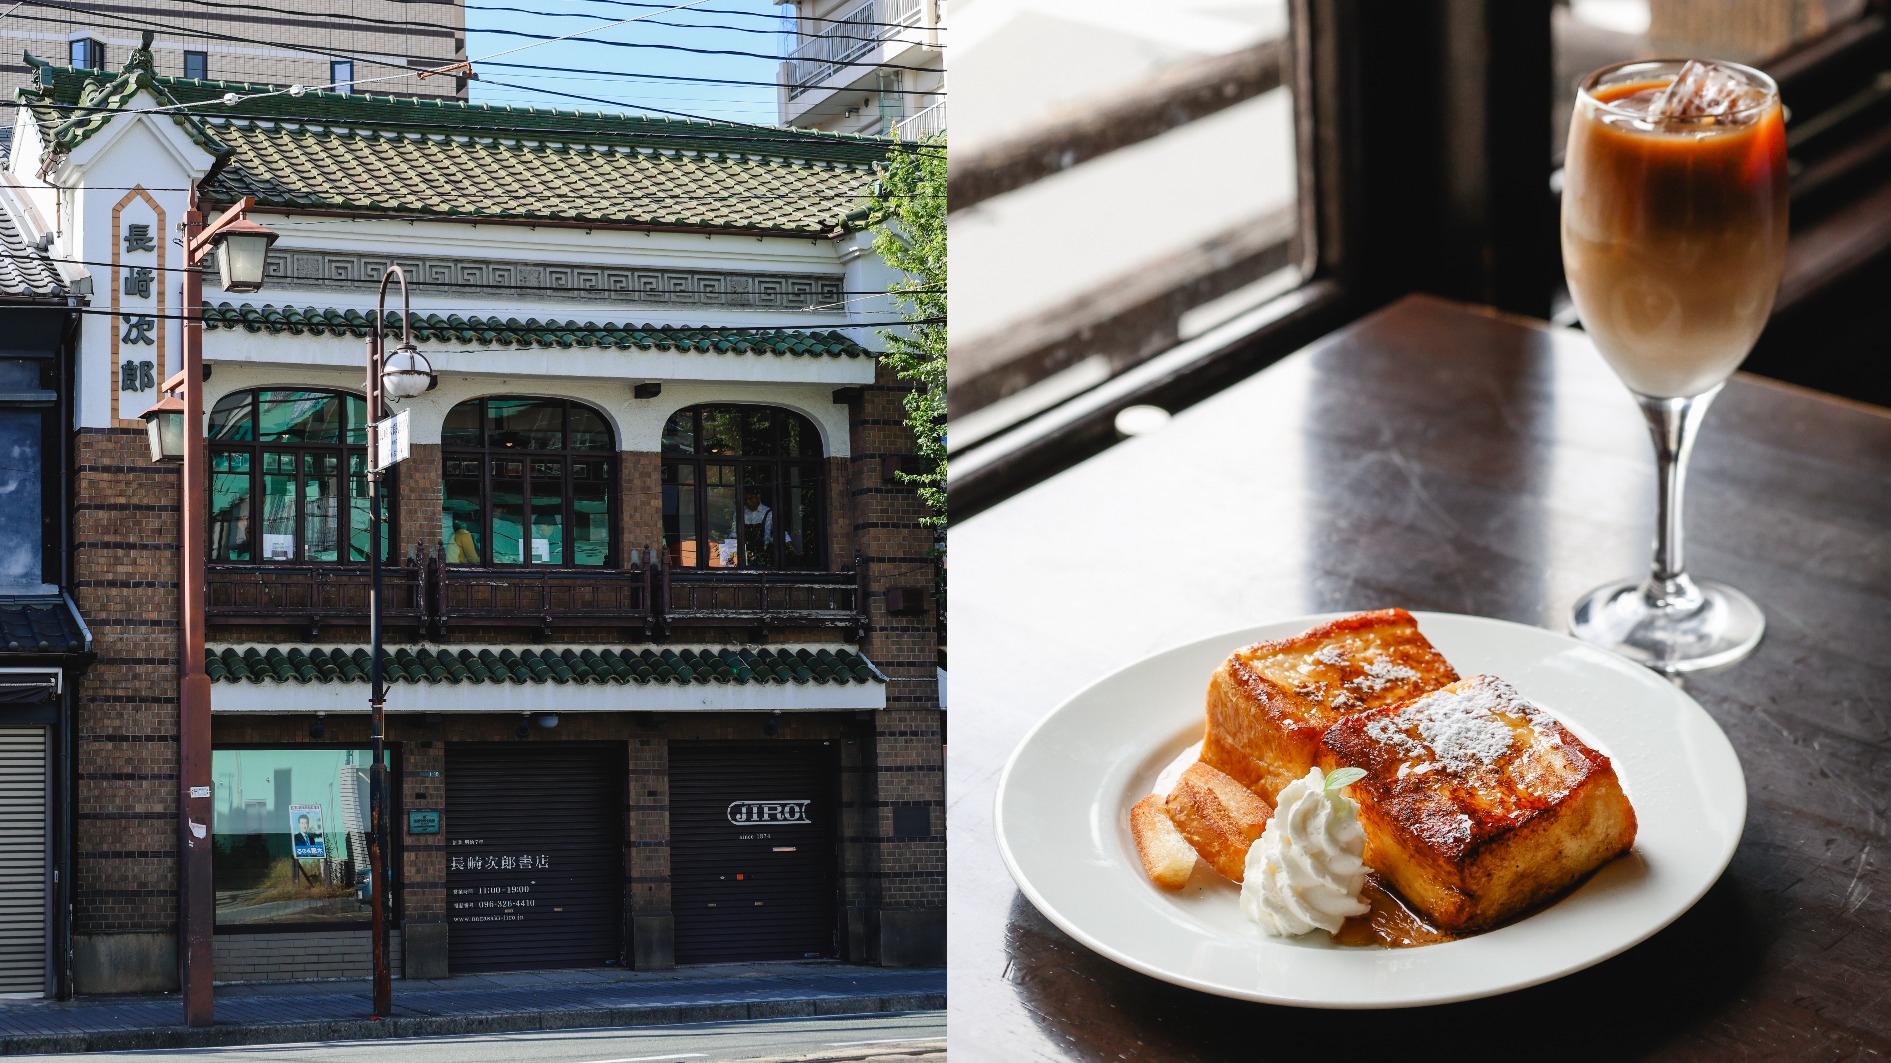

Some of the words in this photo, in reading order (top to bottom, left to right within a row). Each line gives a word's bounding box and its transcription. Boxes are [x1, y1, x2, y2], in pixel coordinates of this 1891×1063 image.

[735, 804, 800, 821] JIRO
[450, 854, 549, 871] 長崎次郎書店
